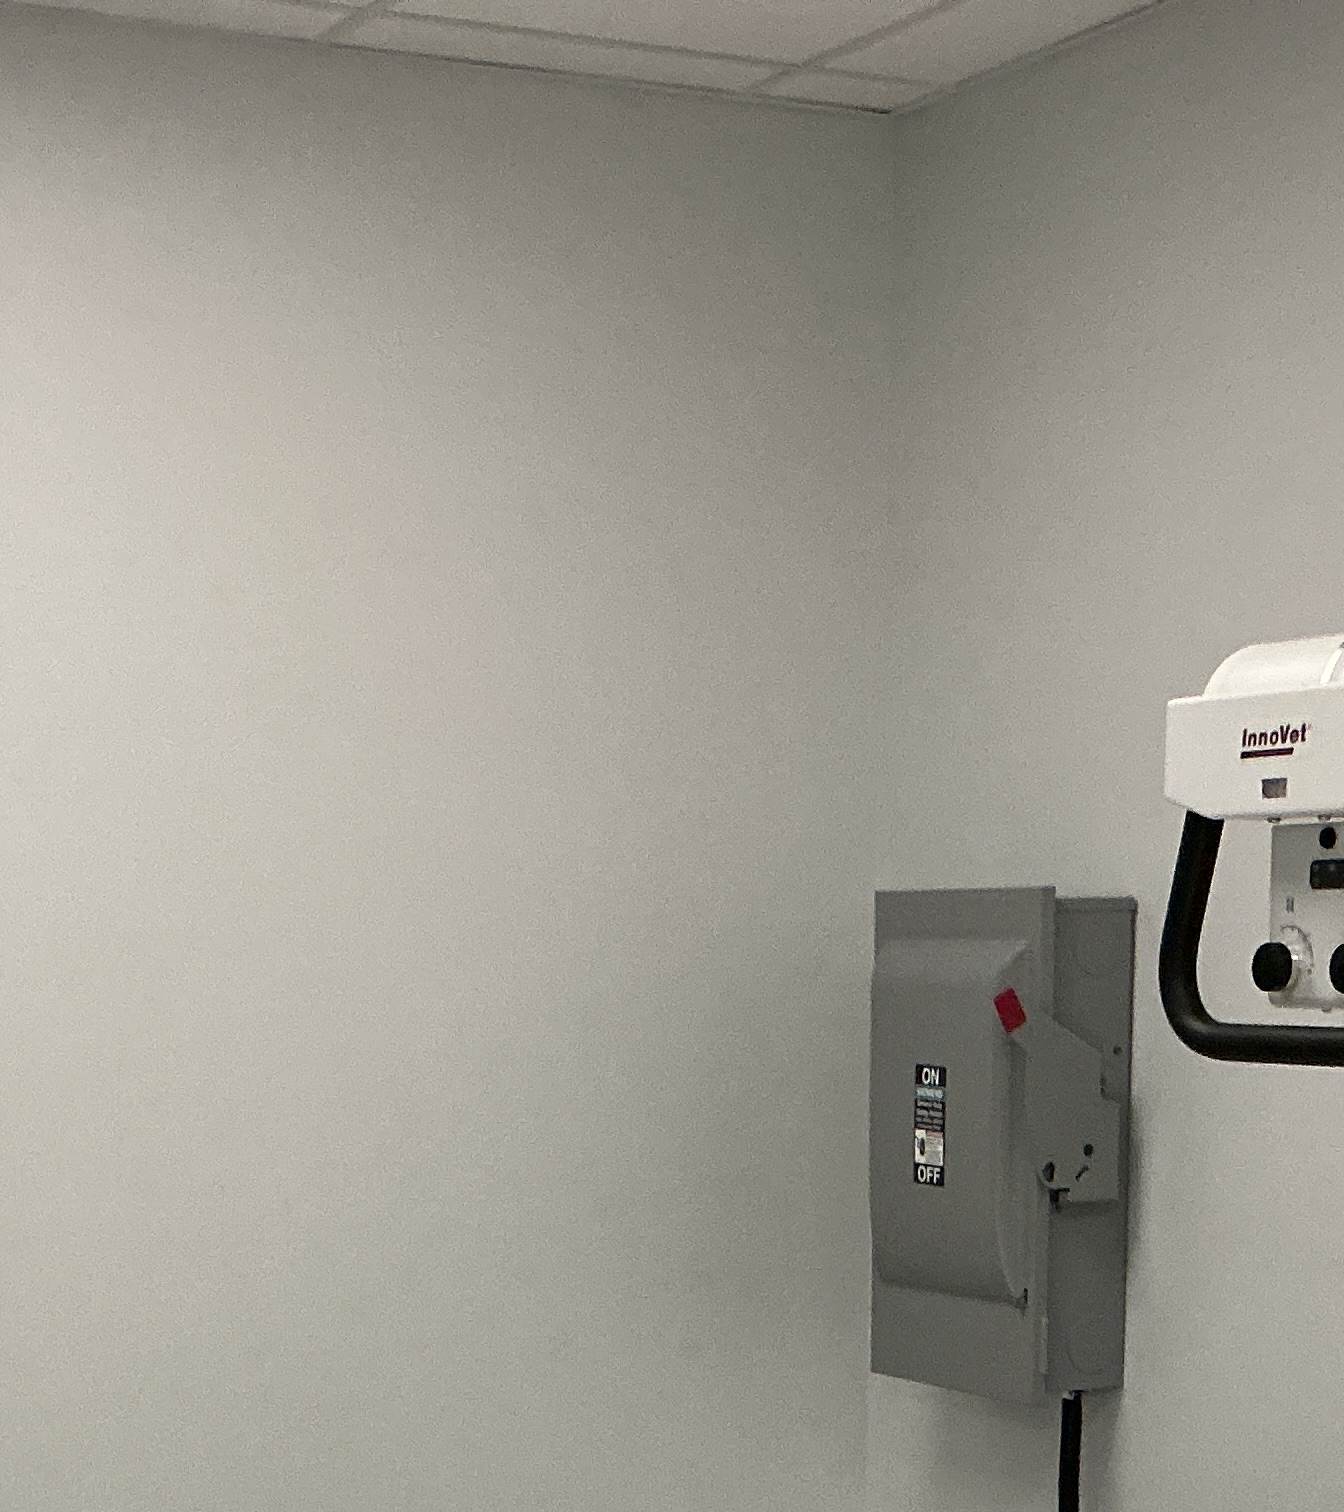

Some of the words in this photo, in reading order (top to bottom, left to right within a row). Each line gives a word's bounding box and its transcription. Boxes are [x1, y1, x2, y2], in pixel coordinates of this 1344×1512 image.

[1241, 723, 1307, 748] InnoVet
[921, 1067, 940, 1086] ON
[917, 1165, 941, 1184] OFF
